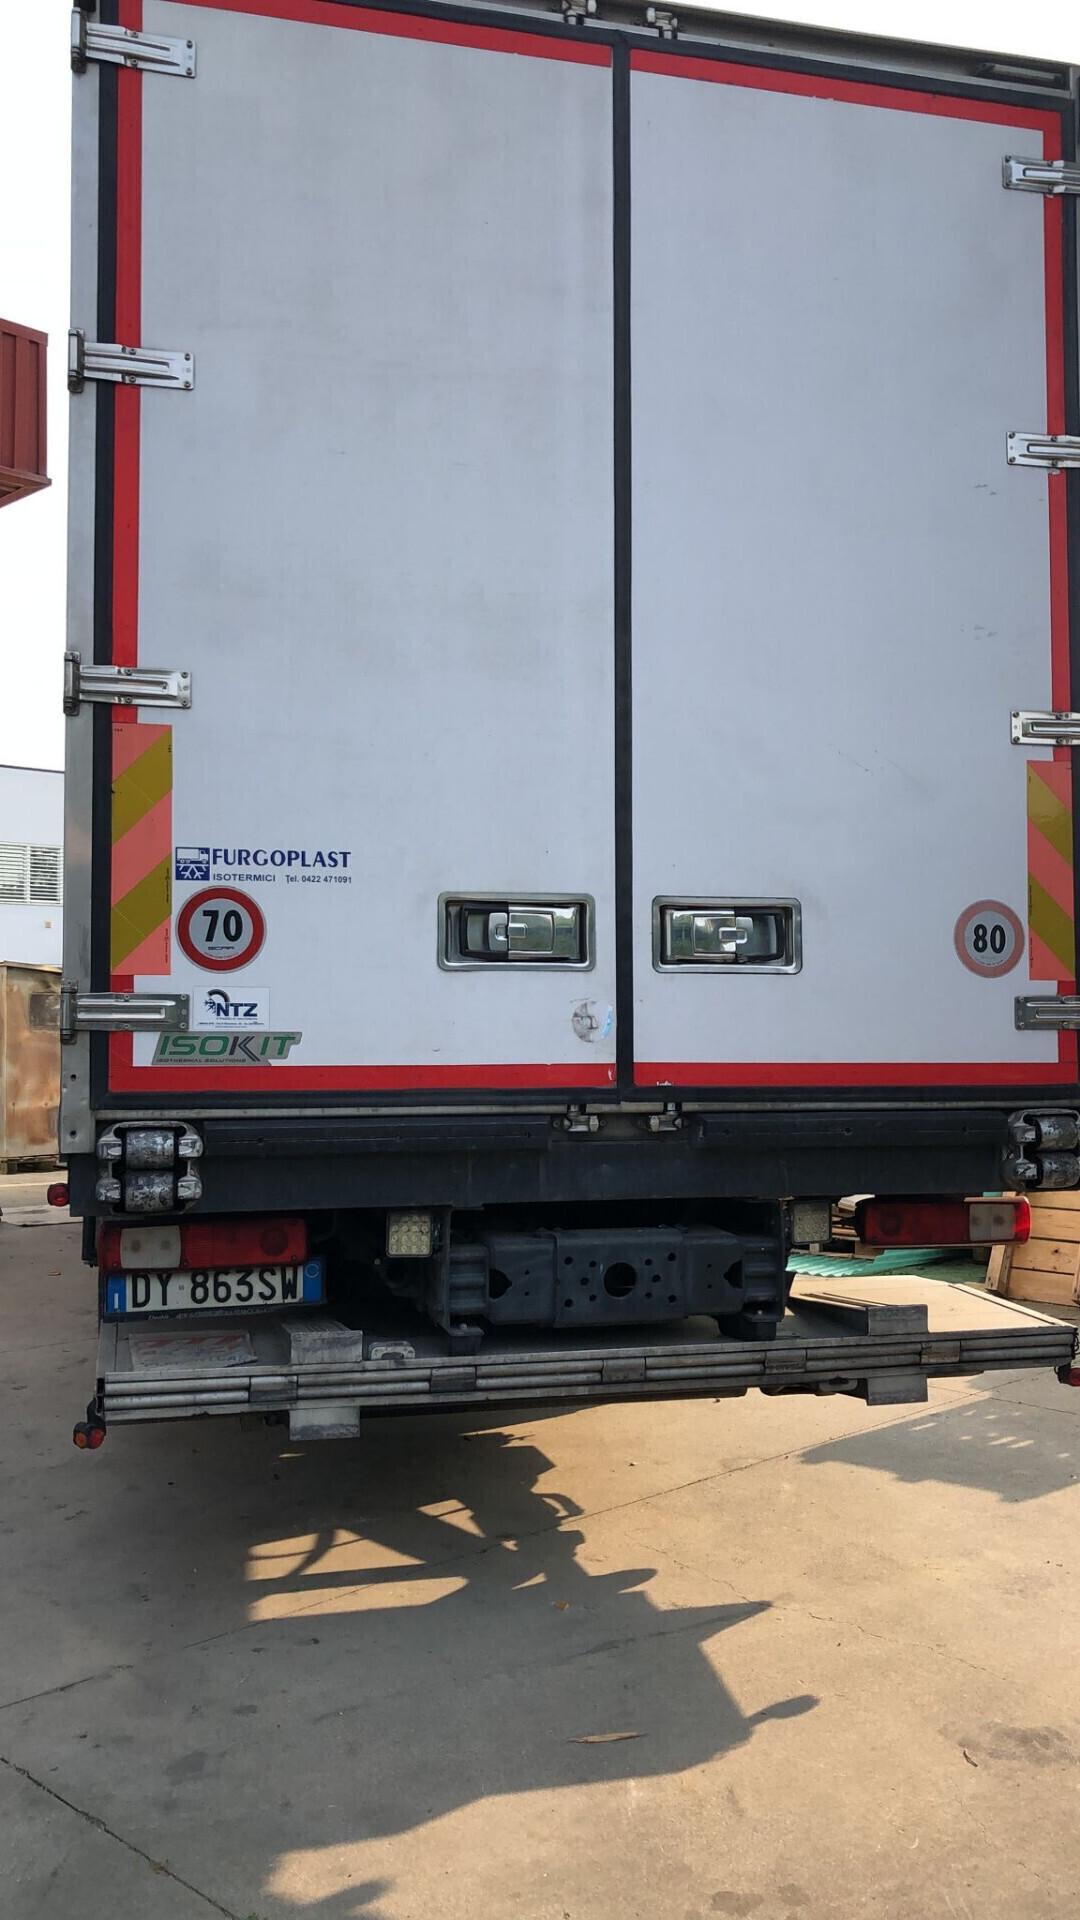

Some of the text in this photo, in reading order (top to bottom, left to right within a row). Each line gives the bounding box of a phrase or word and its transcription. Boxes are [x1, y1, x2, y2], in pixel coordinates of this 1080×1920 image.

[212, 848, 352, 868] FURGOPLAST
[212, 873, 352, 884] ISOTERMICI Tel. 0422 471091
[202, 909, 243, 942] 70
[973, 923, 1006, 954] 80
[216, 1002, 258, 1017] NTZ
[159, 1035, 296, 1062] ISOKIT
[132, 1265, 298, 1308] DY 863SW
